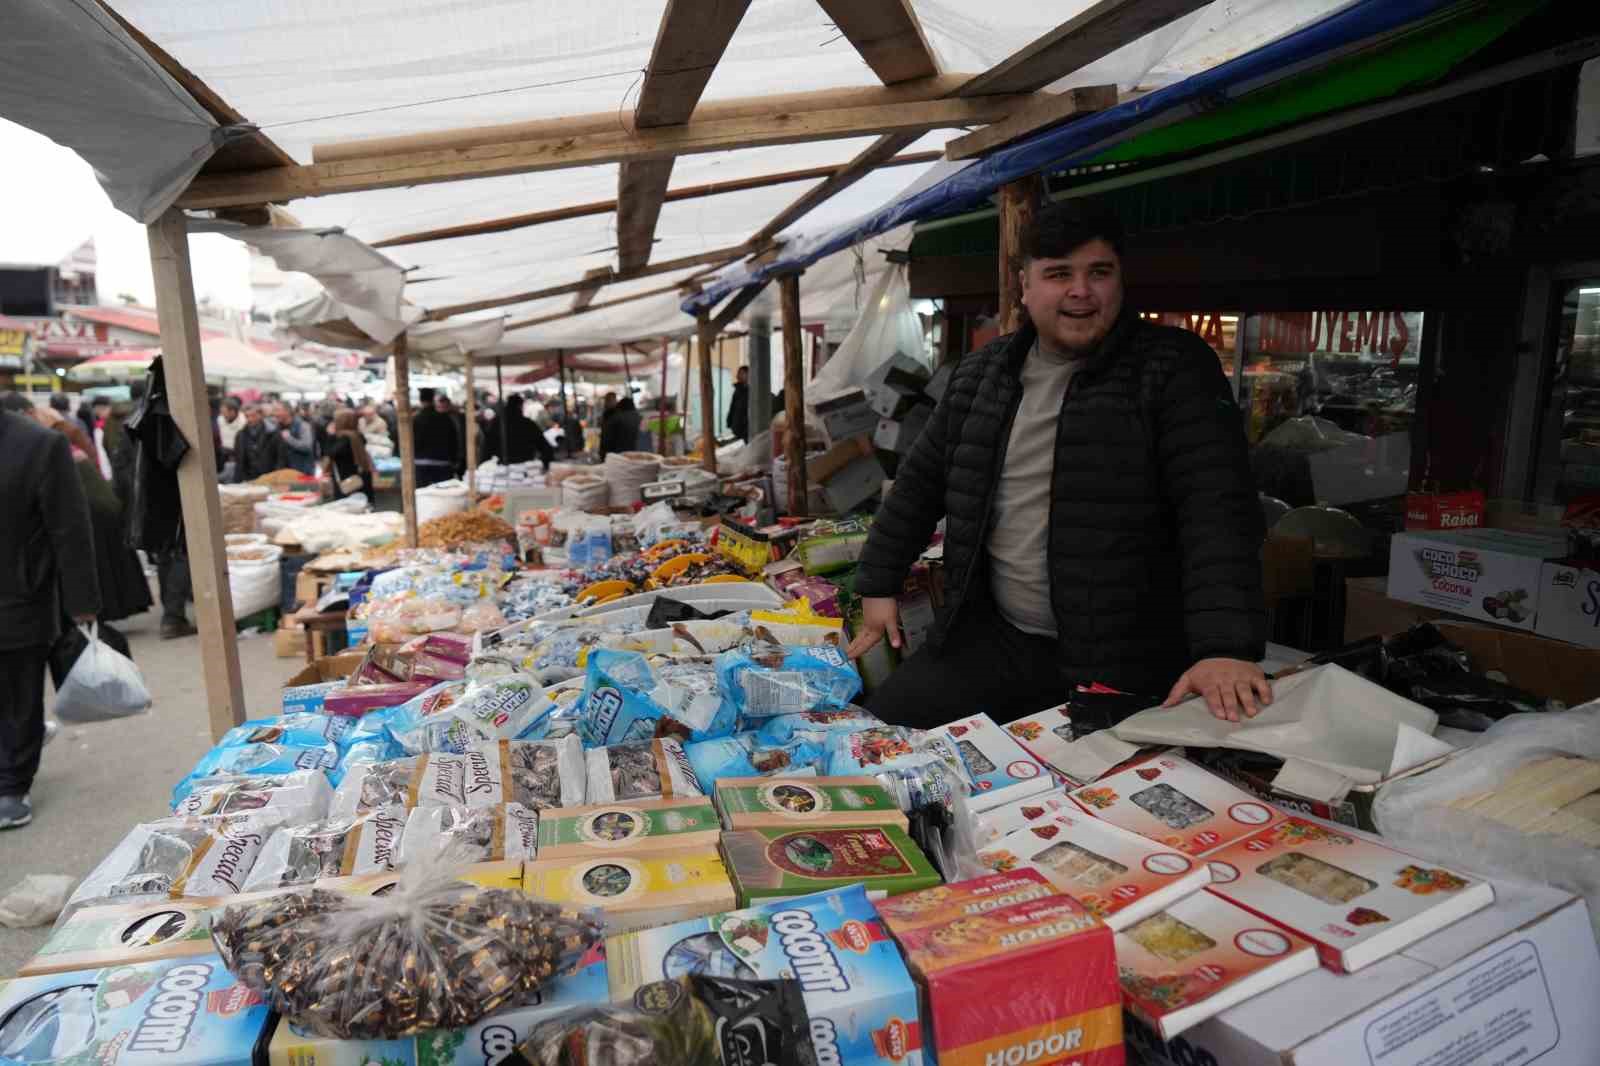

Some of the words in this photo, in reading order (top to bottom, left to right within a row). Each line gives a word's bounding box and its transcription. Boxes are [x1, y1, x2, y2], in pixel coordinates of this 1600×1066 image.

[1422, 549, 1456, 564] COCO
[1432, 564, 1478, 582] SHOCO
[431, 757, 464, 803] Special
[212, 832, 262, 895] Special
[769, 909, 850, 992] COCOTAT
[127, 964, 214, 1053] COCOTAT
[985, 1027, 1084, 1066] HODOR
